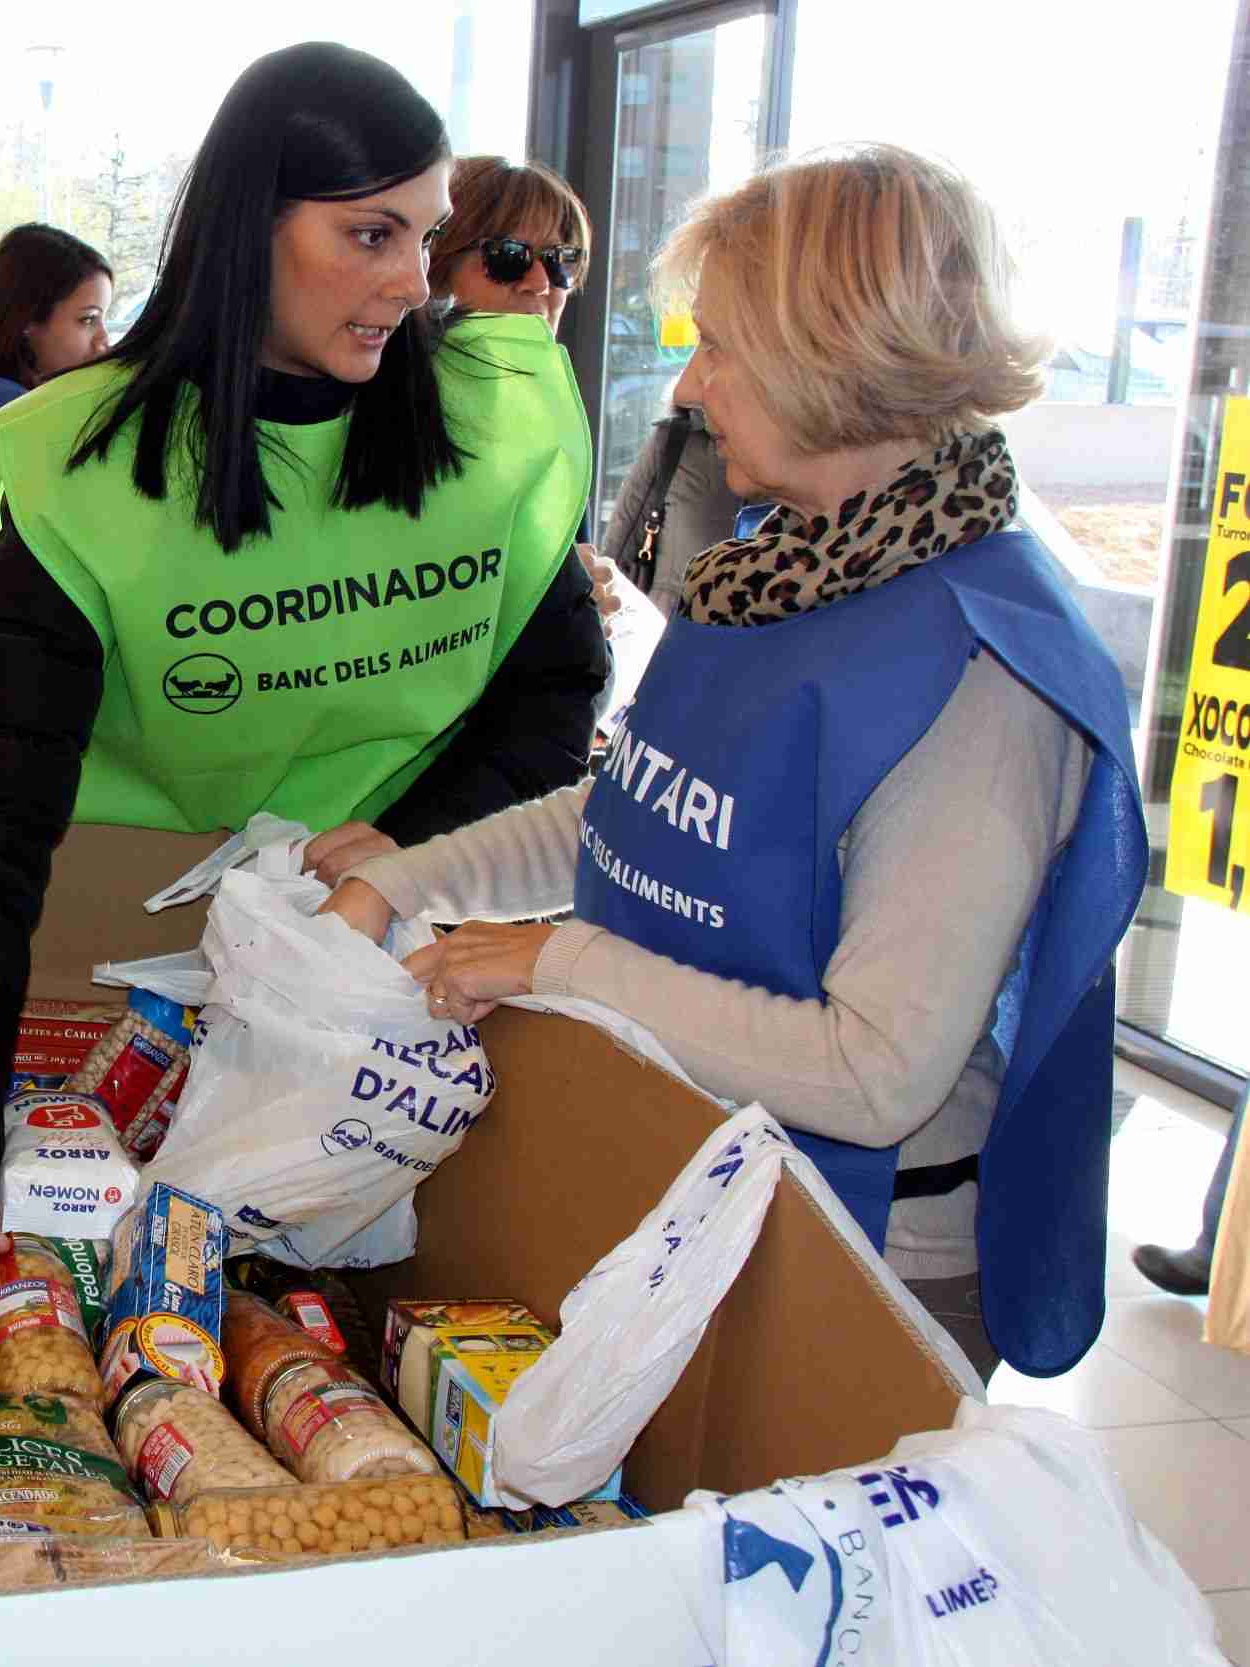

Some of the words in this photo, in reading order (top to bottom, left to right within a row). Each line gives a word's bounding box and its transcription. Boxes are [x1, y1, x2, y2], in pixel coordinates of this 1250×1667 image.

[166, 547, 503, 639] COORDINADOR
[256, 664, 328, 692] BANC
[334, 651, 392, 683] DELS
[398, 617, 491, 670] ALIMENTS
[1183, 742, 1245, 770] Chocolate
[609, 857, 725, 928] ALIMENTS
[35, 1148, 111, 1161] ARROZ
[52, 1202, 96, 1213] ARROZ
